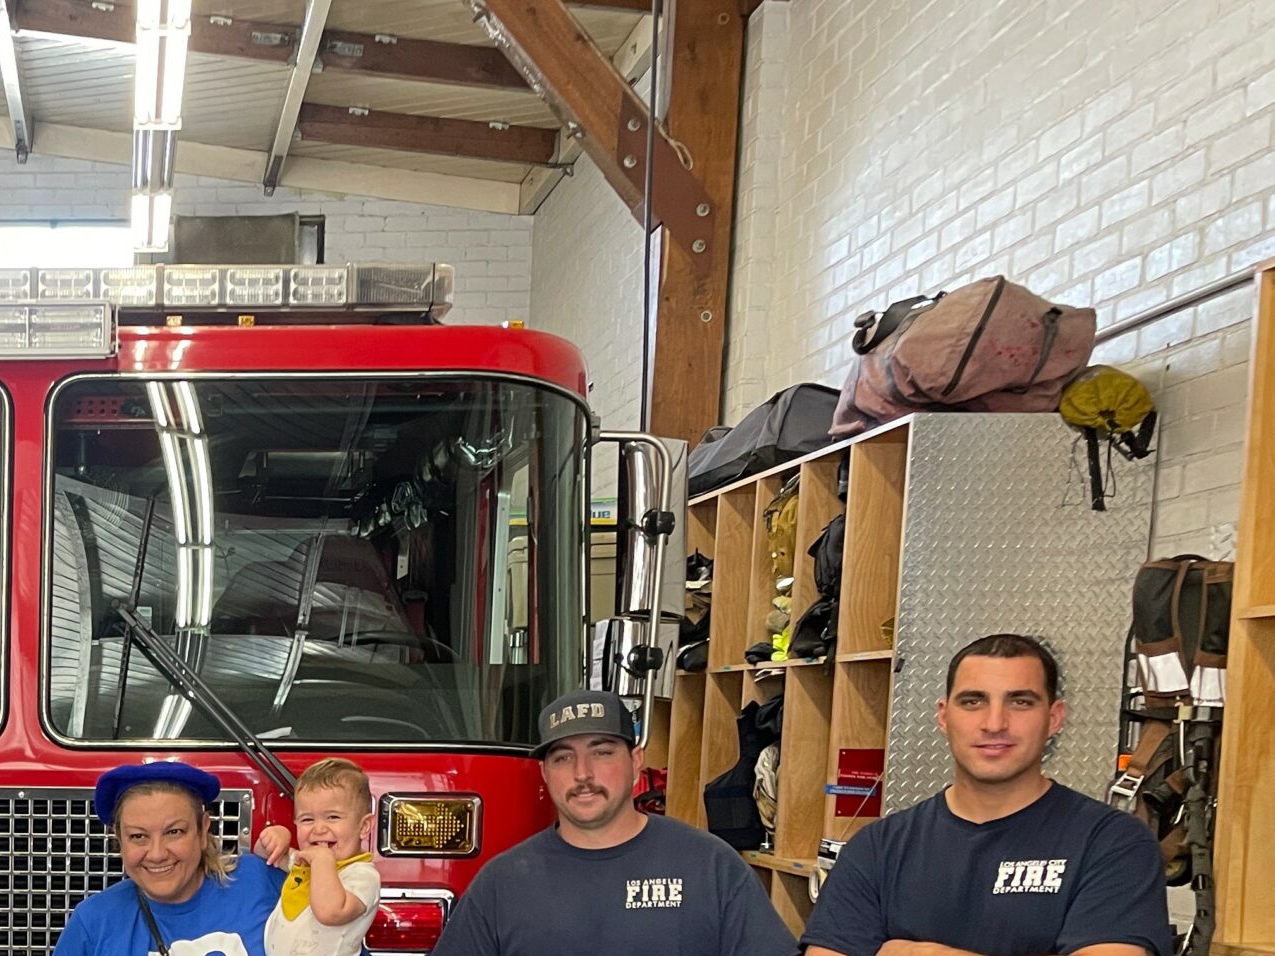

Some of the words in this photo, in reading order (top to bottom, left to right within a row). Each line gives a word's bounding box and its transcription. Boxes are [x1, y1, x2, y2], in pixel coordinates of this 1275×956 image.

[549, 702, 605, 729] LAFD
[994, 866, 1066, 888] FIRE
[626, 885, 683, 902] FIRE
[992, 886, 1060, 895] DEPARTMENT
[625, 901, 681, 909] DEPARTMENT
